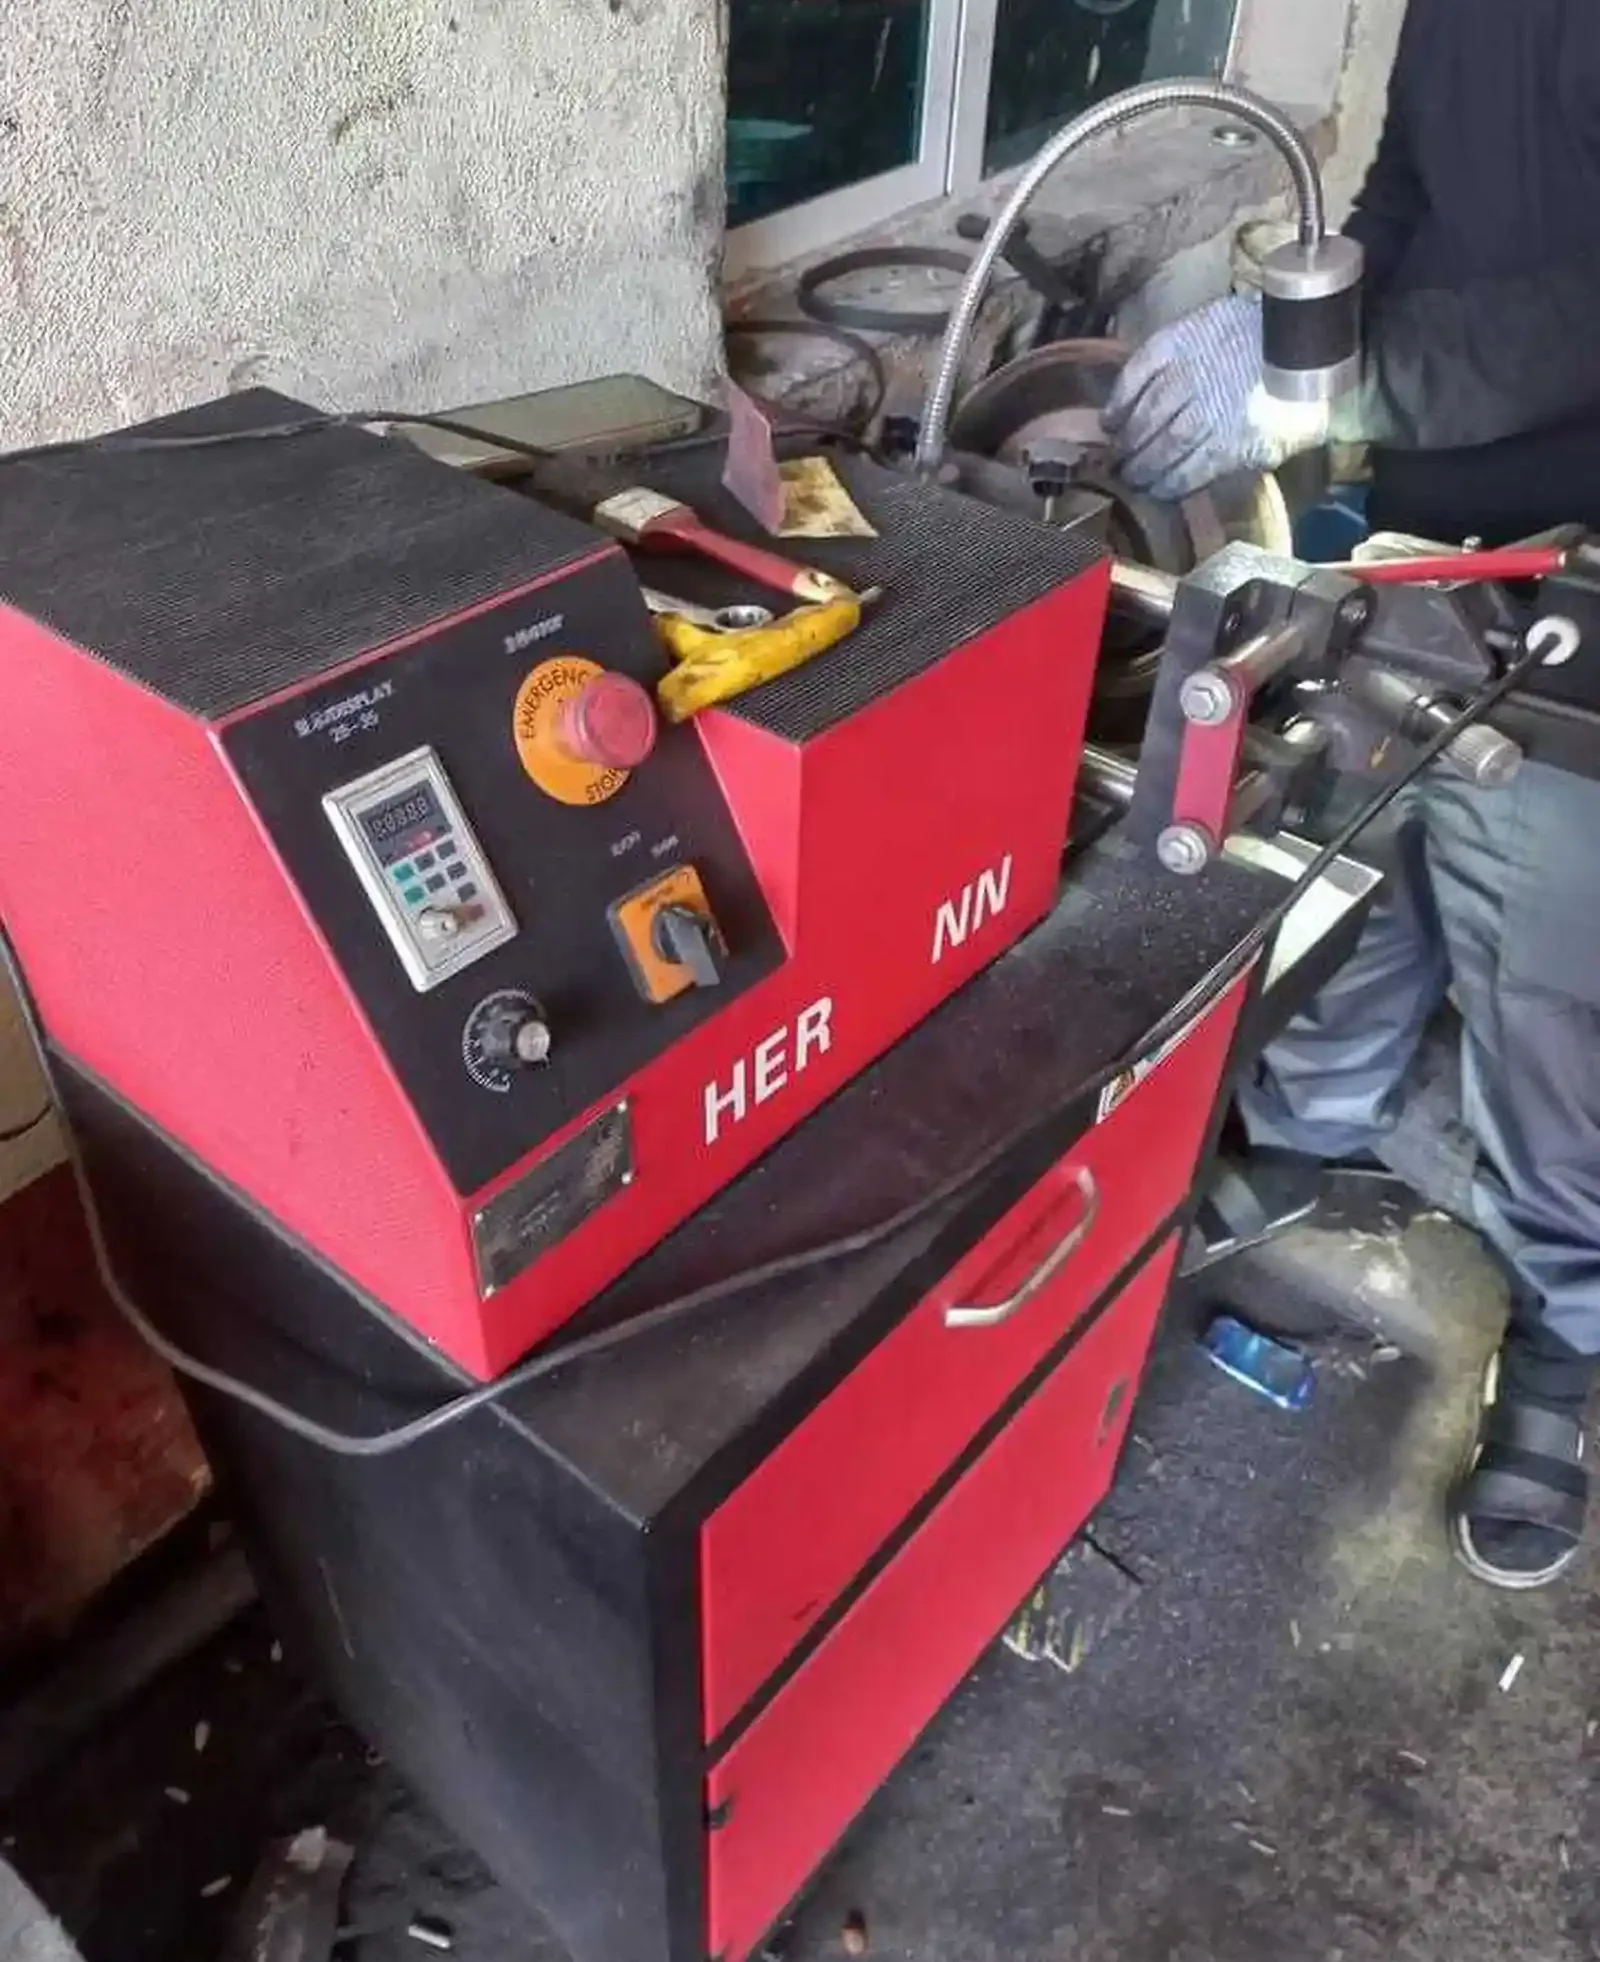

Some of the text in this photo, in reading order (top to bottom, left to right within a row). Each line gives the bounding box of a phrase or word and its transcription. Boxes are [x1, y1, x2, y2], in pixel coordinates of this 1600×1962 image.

[520, 667, 590, 739] EMERGENC
[704, 854, 1012, 1144] HER NN
